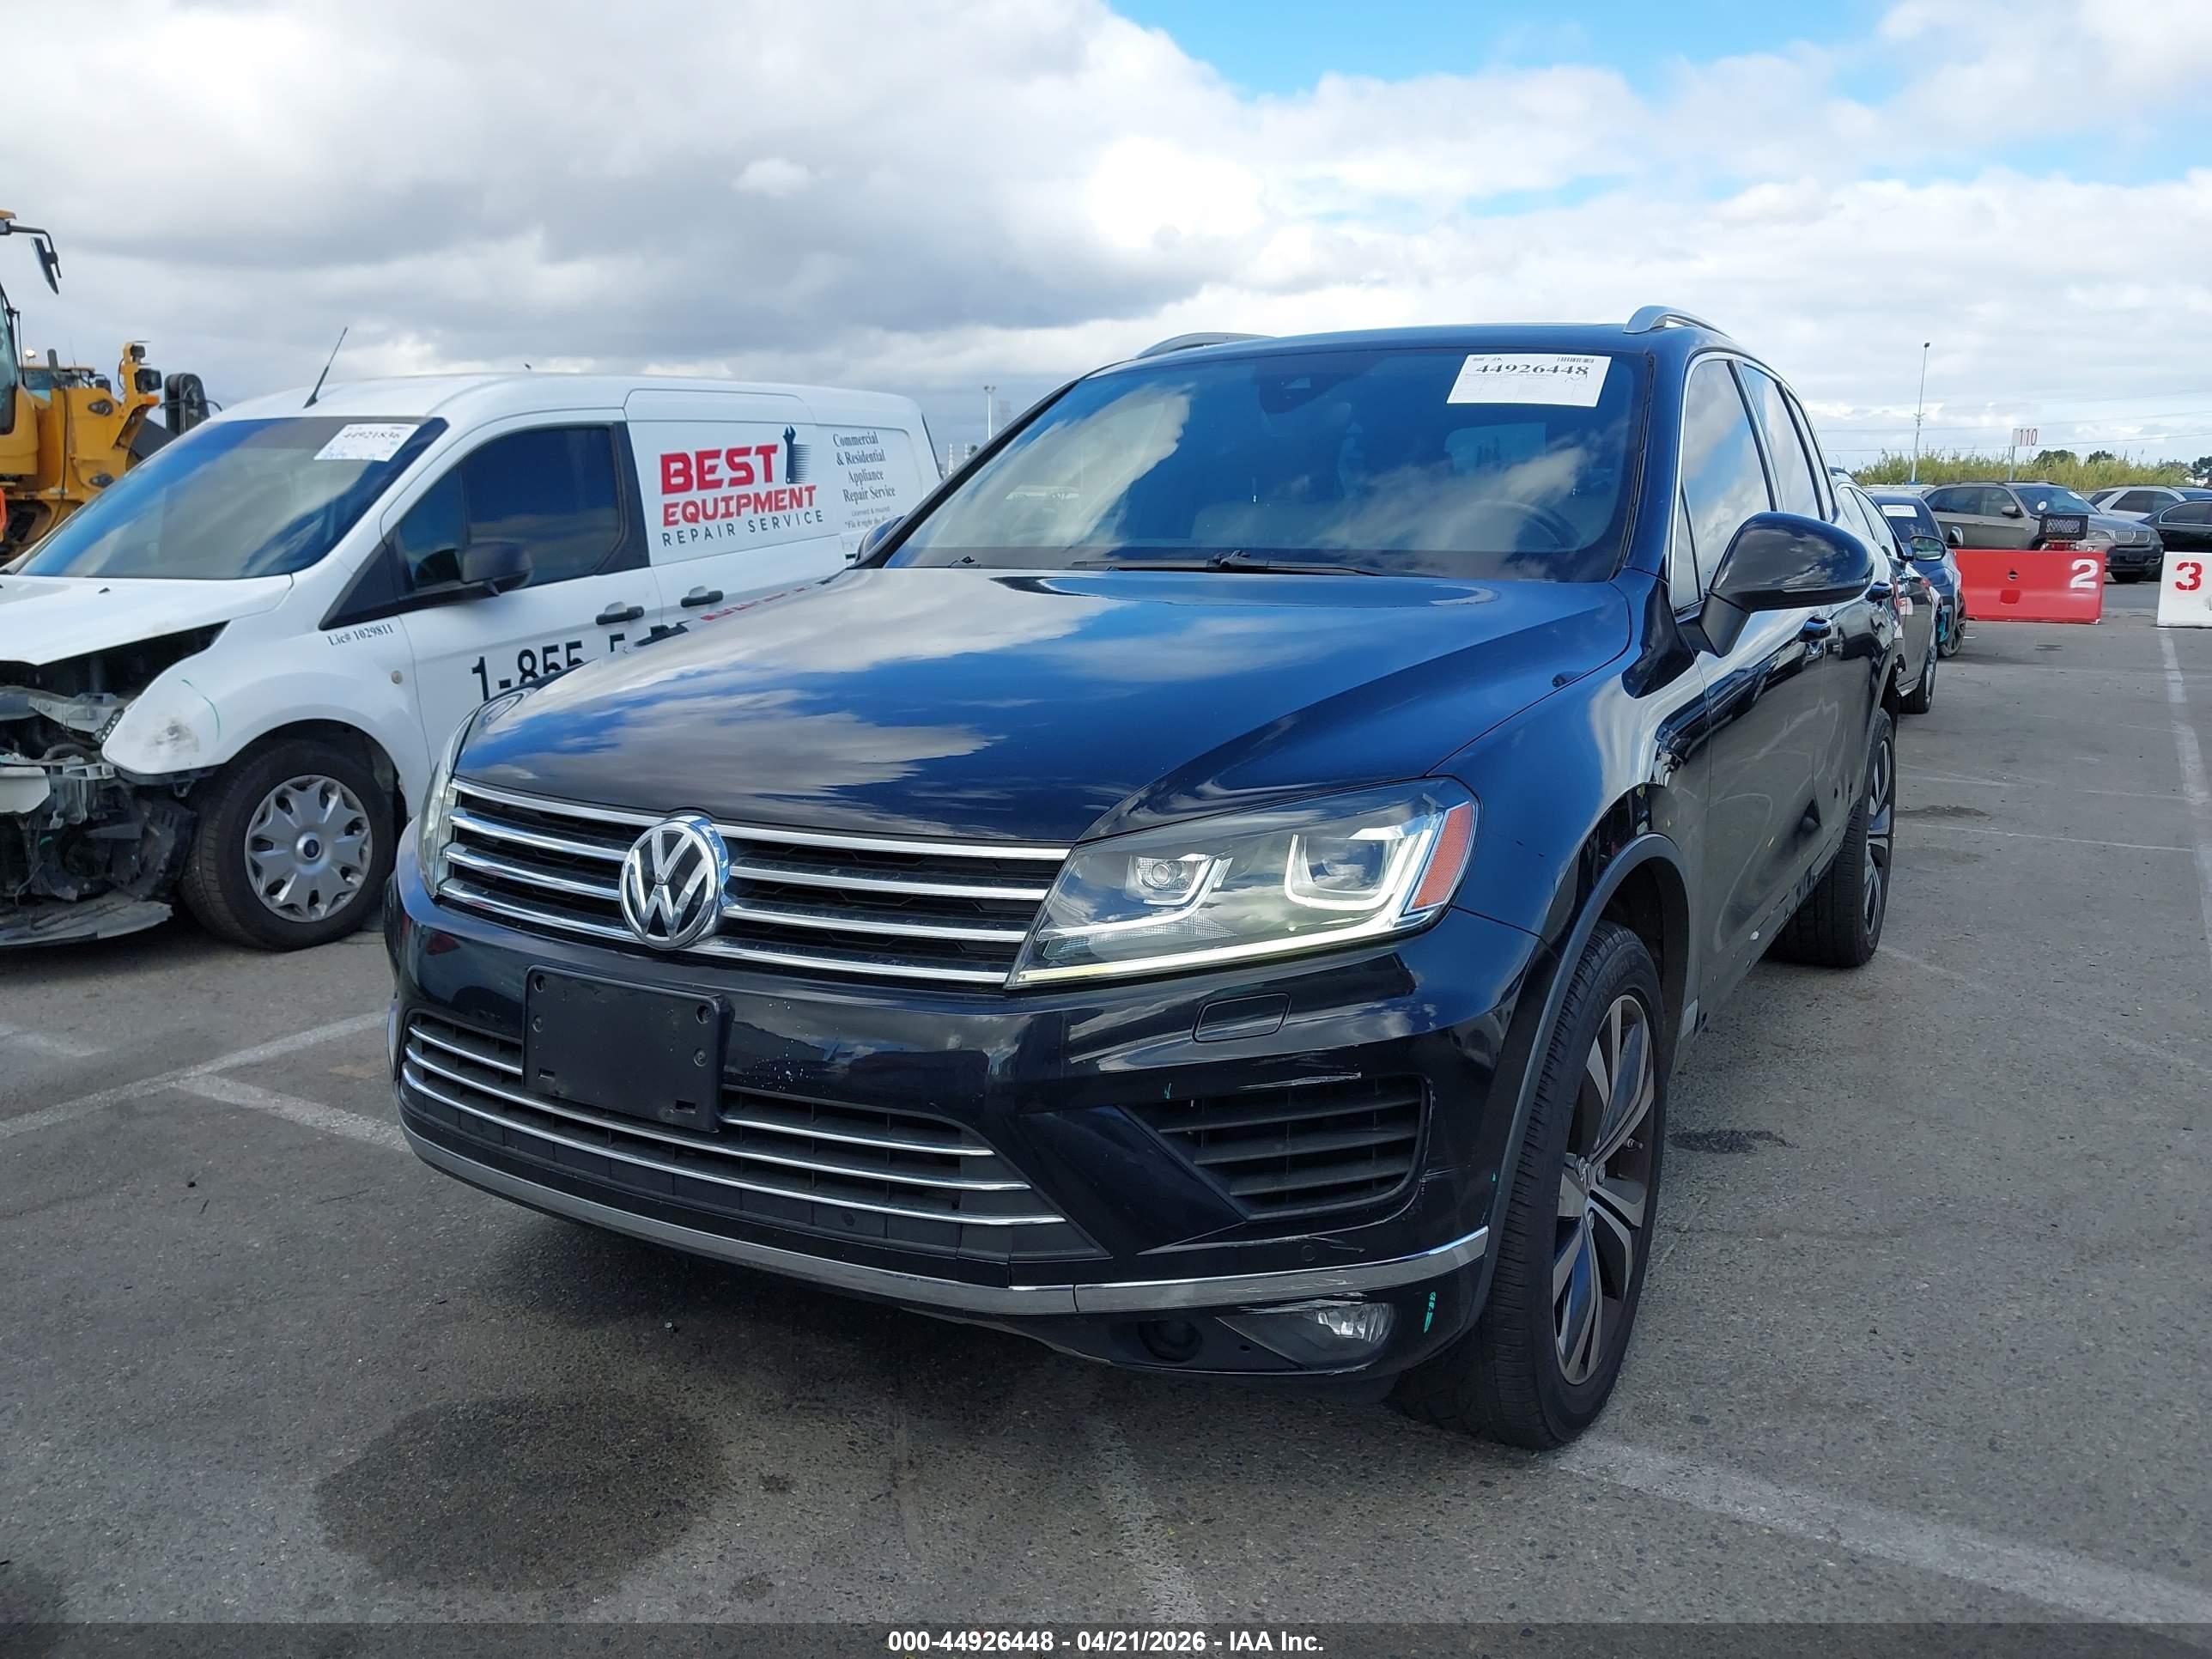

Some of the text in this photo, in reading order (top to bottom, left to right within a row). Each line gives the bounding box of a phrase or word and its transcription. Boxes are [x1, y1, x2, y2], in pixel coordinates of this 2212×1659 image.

[1475, 363, 1589, 375] 44926448
[832, 431, 879, 447] Commercial
[2019, 428, 2038, 447] 110
[836, 448, 886, 466] & Residential
[659, 443, 779, 495] BEST
[848, 469, 884, 487] Appliance
[842, 484, 896, 505] Repair Service
[662, 484, 817, 527] EQUIPMENT
[661, 522, 736, 547] REPAIR
[747, 509, 824, 533] SERVICE
[2069, 558, 2099, 589] 2
[2175, 561, 2203, 591] 3
